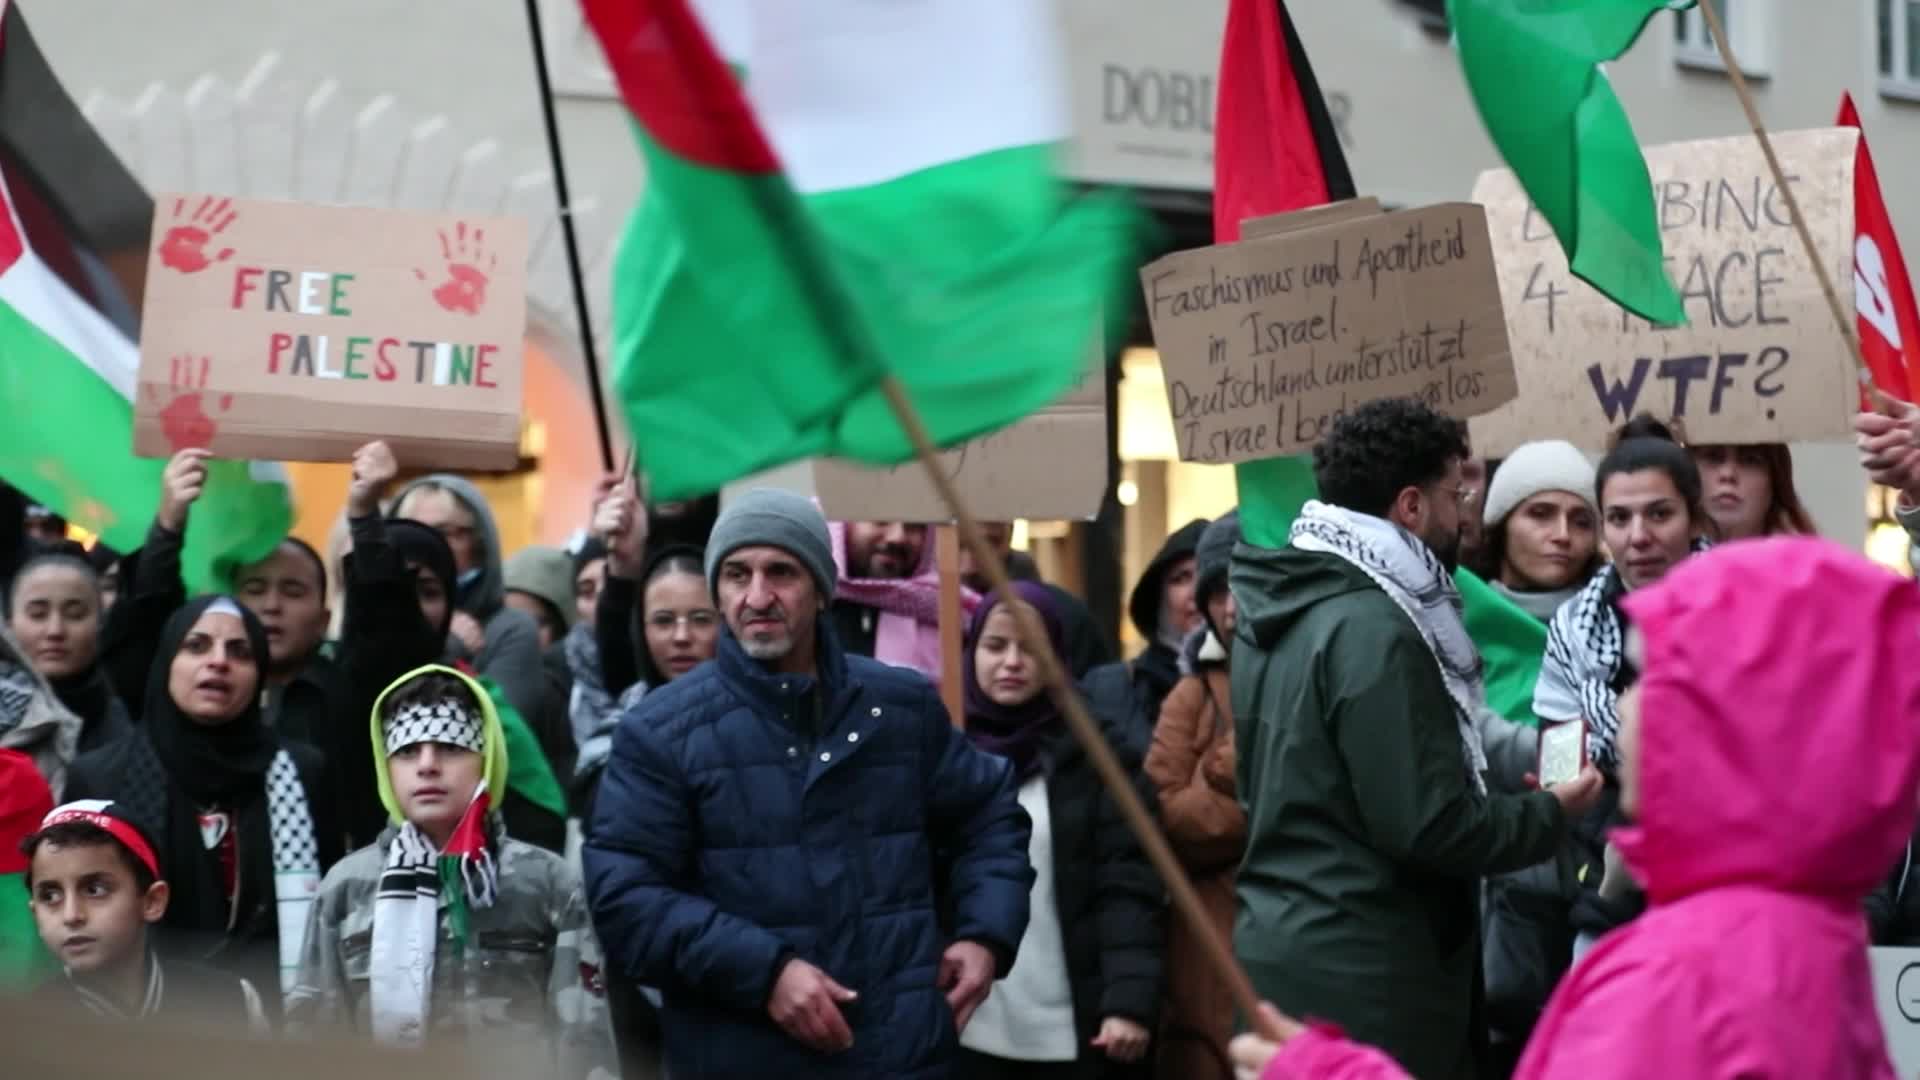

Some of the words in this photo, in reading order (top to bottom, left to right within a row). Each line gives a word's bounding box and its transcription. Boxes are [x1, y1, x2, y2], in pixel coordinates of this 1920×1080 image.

[230, 267, 356, 317] FREE
[1151, 266, 1294, 321] Faschismus
[1302, 239, 1343, 288] und
[1351, 215, 1468, 301] Apartheid
[1521, 262, 1568, 333] 4
[267, 333, 500, 388] PALESTINE
[1208, 334, 1228, 364] in
[1241, 296, 1349, 358] Israel.
[1172, 354, 1321, 420] Deutschland
[1324, 318, 1473, 386] unterstützt
[1587, 346, 1790, 424] WTF?
[1183, 403, 1283, 463] Israel
